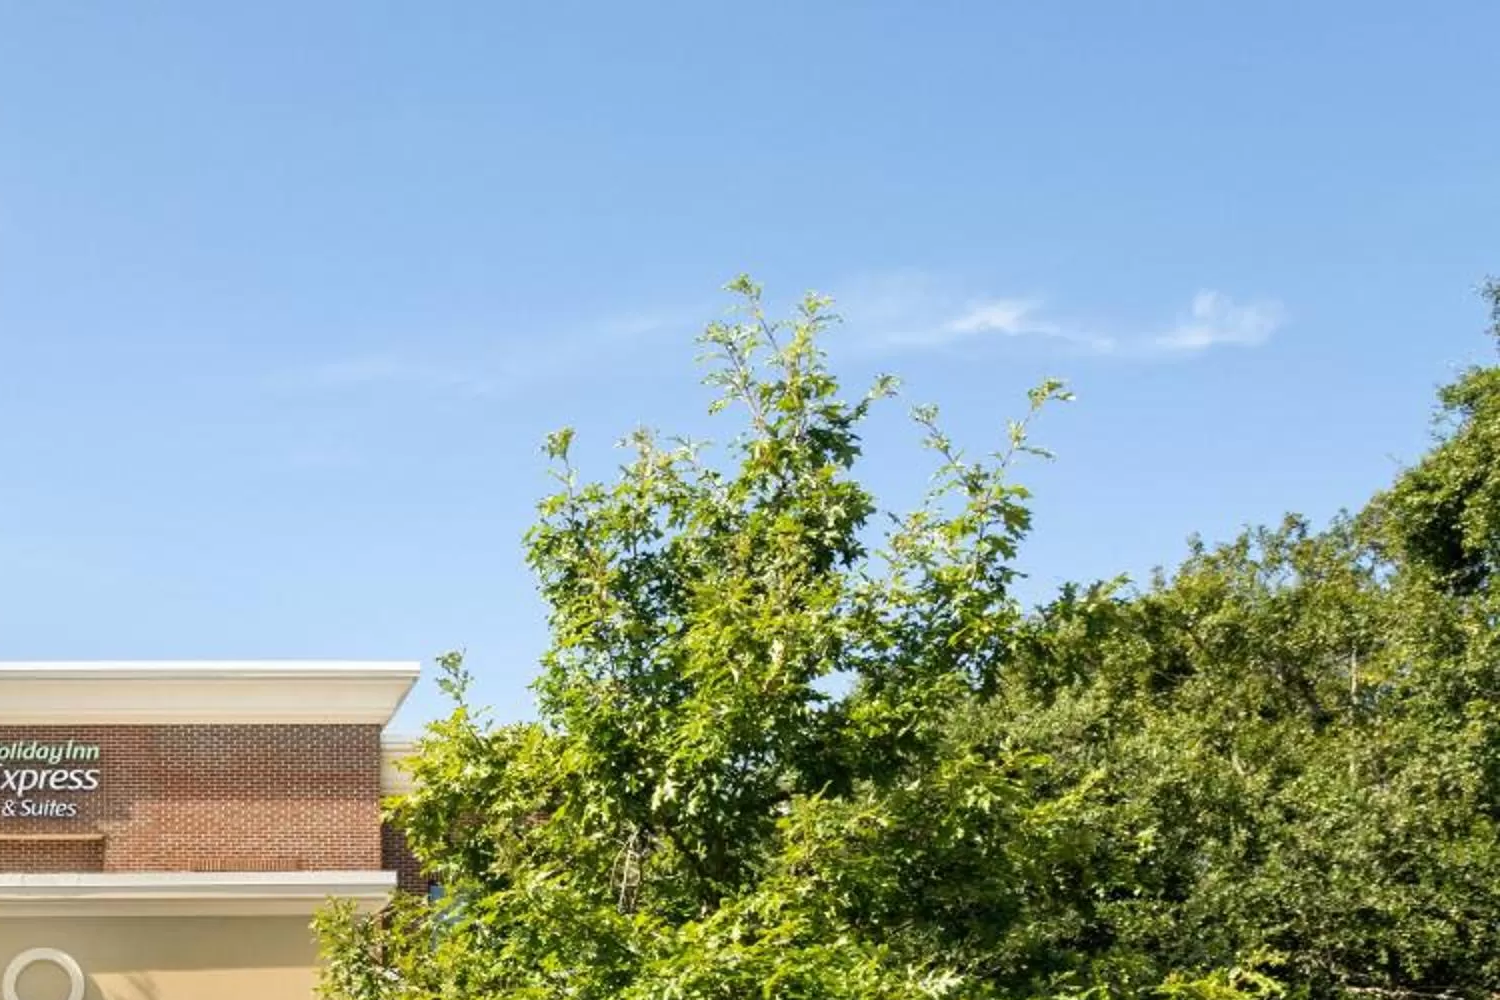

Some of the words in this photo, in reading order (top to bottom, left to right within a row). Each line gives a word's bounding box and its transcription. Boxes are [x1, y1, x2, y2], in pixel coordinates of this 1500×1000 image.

[65, 739, 100, 760] Inn
[1, 799, 16, 817] &
[19, 799, 77, 817] Suites
